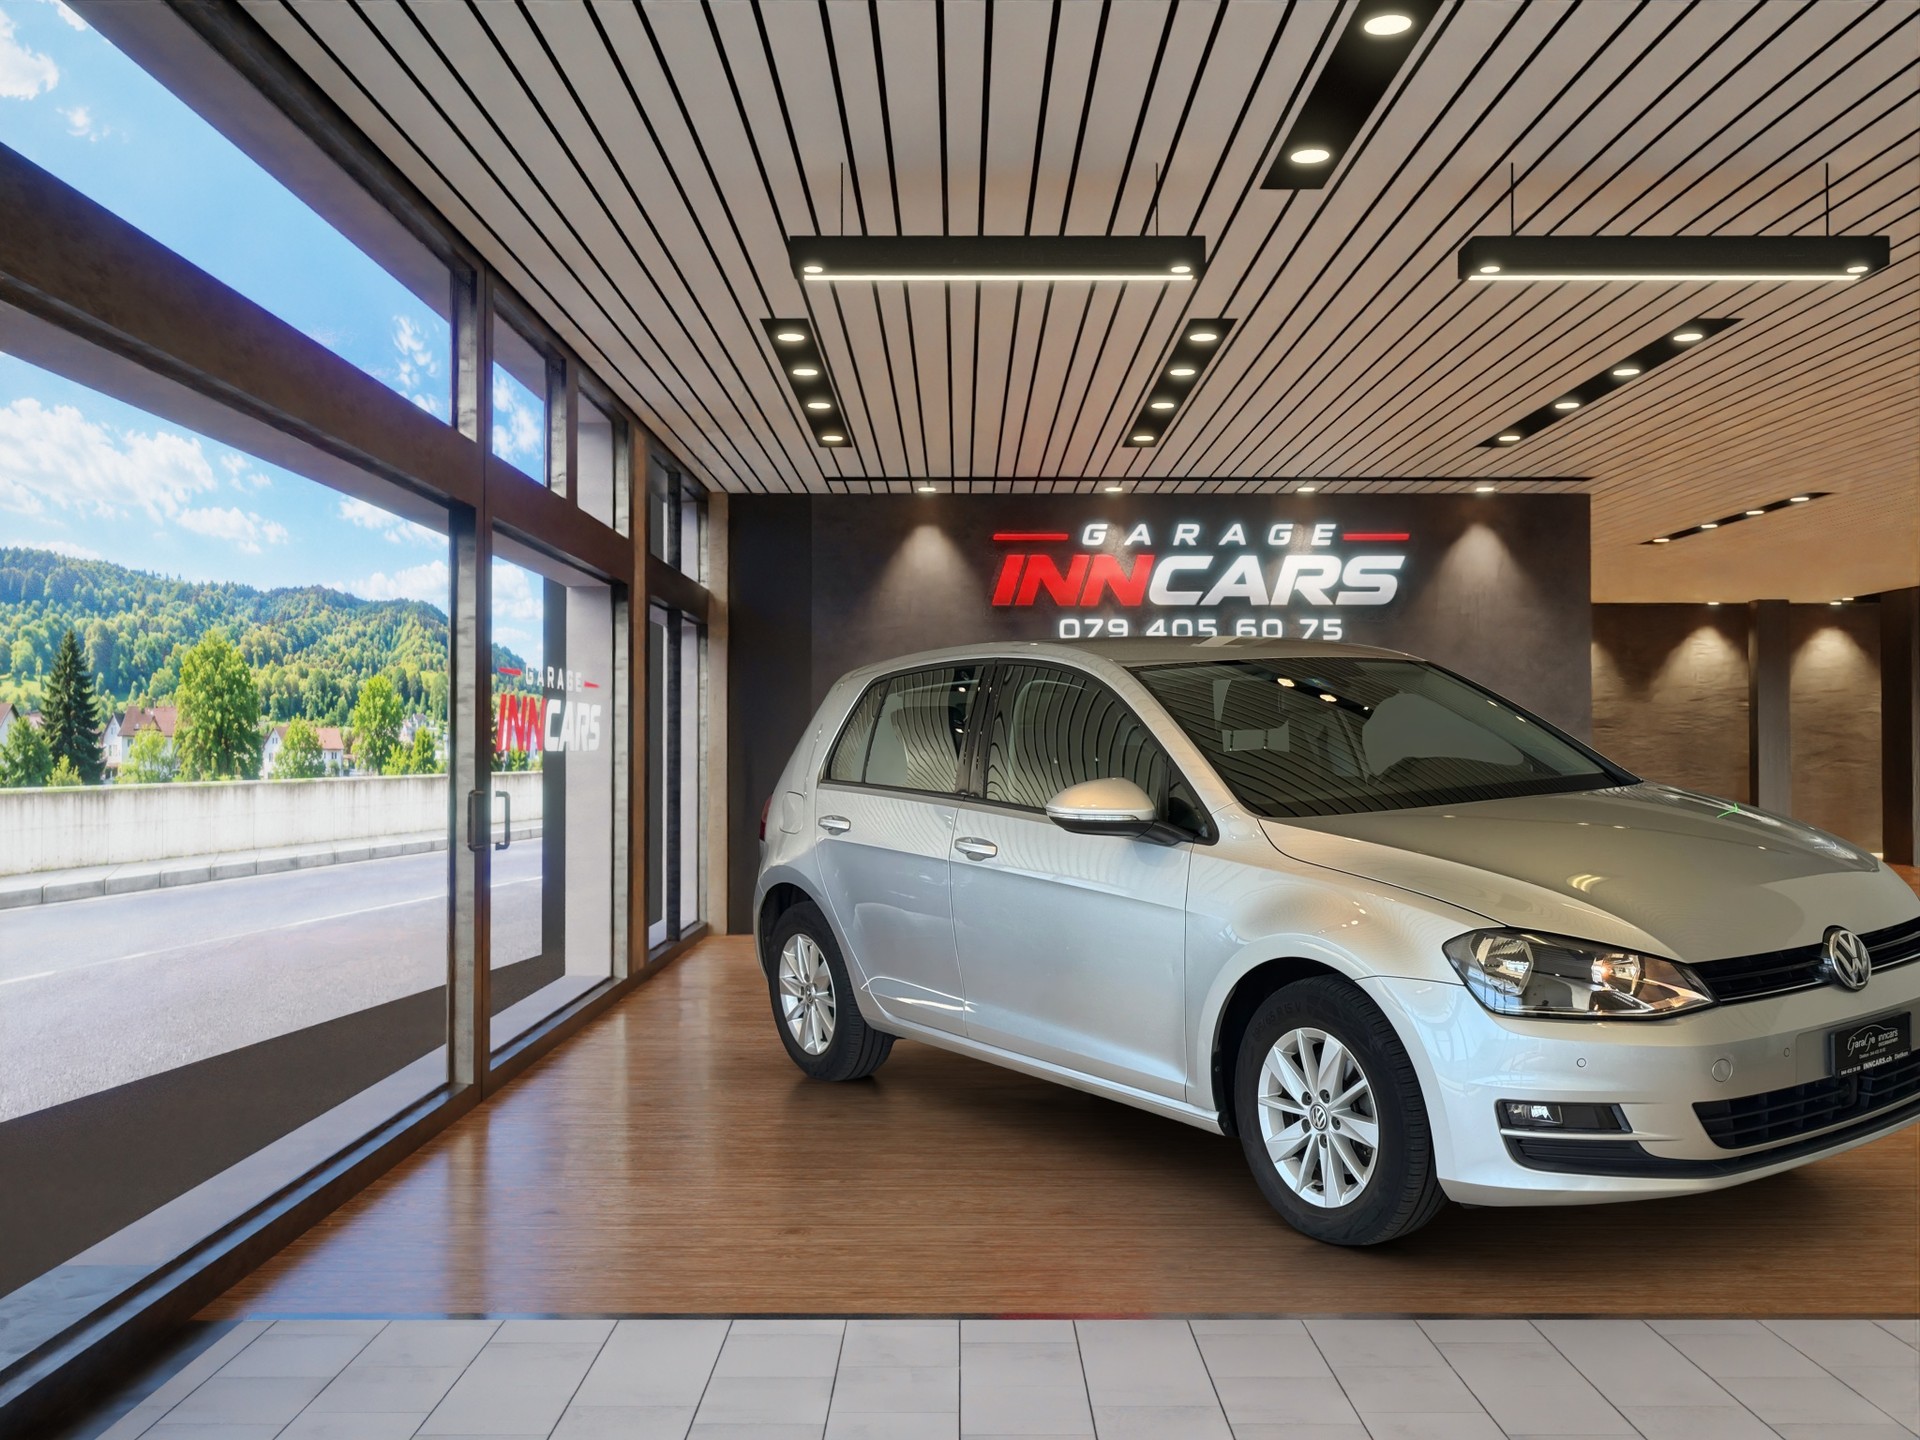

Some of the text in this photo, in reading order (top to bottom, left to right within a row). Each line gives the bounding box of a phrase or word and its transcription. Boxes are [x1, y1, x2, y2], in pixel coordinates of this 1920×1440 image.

[1082, 523, 1336, 547] GARAGE
[992, 554, 1406, 607] INNCARS
[1059, 618, 1343, 641] 079 405 60 75
[525, 664, 583, 693] GARAGE
[496, 693, 602, 752] INNCARS
